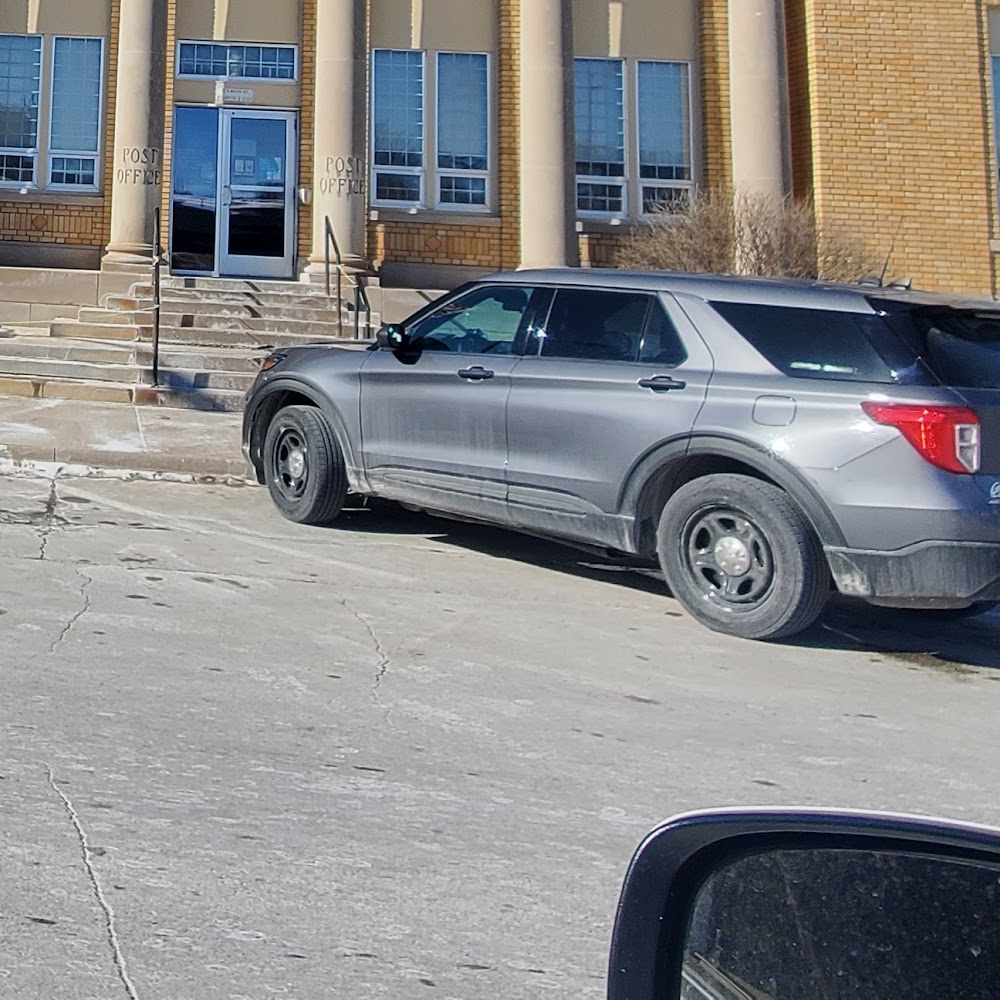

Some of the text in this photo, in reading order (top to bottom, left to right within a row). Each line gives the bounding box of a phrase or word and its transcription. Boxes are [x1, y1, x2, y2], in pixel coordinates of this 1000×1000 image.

[123, 148, 158, 164] POST
[326, 157, 363, 174] POST
[117, 168, 161, 185] OFFICE
[320, 177, 365, 194] OFFICE
